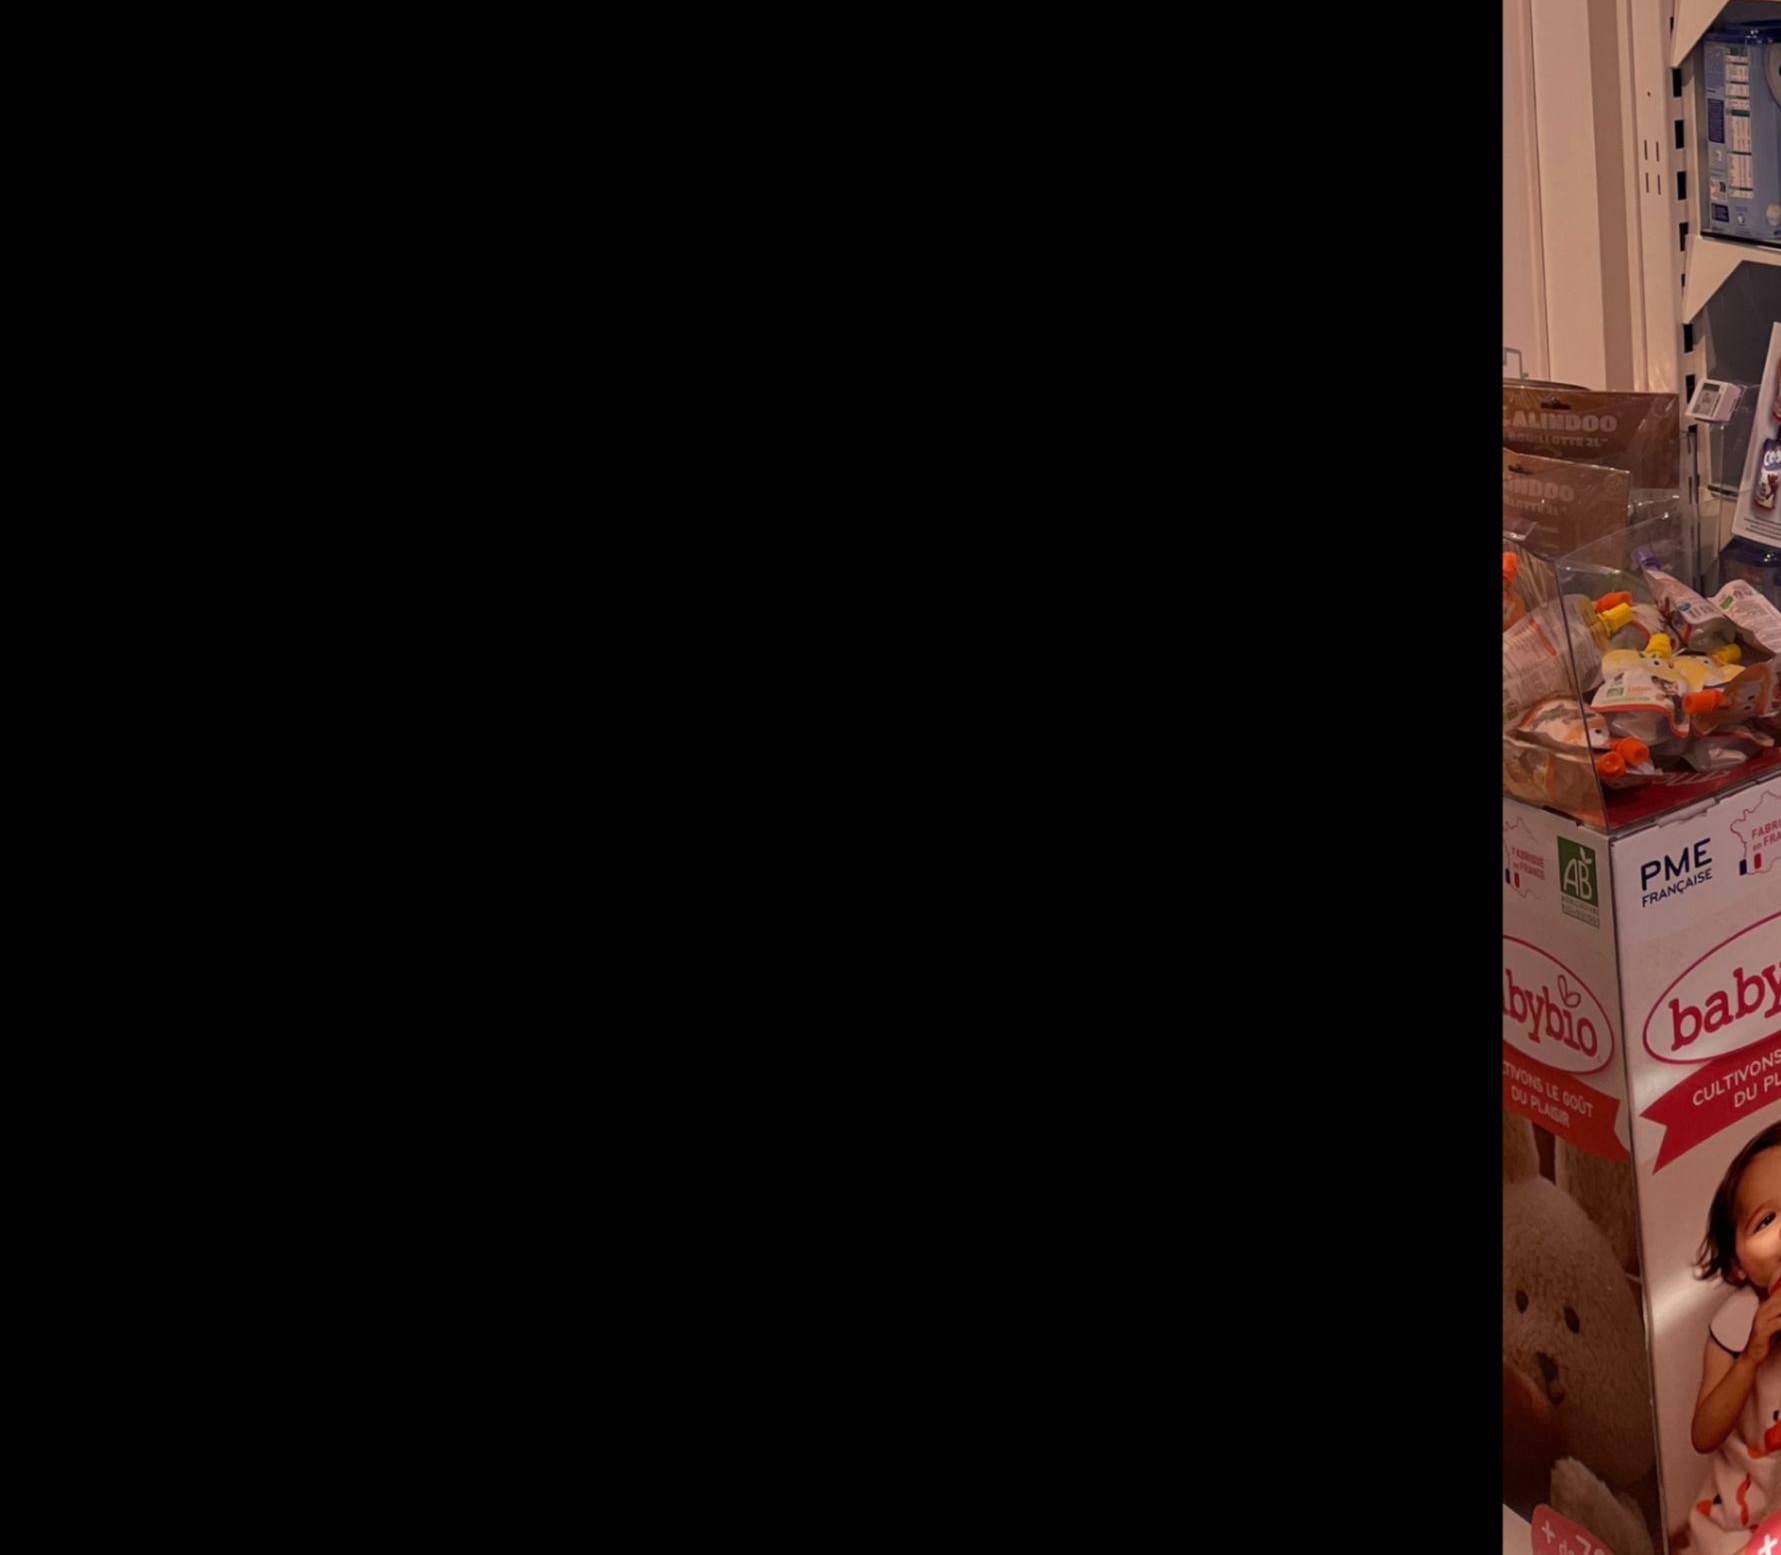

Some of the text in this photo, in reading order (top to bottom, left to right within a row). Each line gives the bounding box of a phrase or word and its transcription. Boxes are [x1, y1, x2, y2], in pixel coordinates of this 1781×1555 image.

[1563, 858, 1592, 900] AB
[1640, 837, 1713, 892] PME
[1642, 868, 1713, 908] FRANÇAISE
[1503, 968, 1598, 1058] bybio
[1511, 1086, 1571, 1127] DU PLAISIR
[1545, 1078, 1595, 1119] LE GOÛT
[1733, 1086, 1759, 1108] DU
